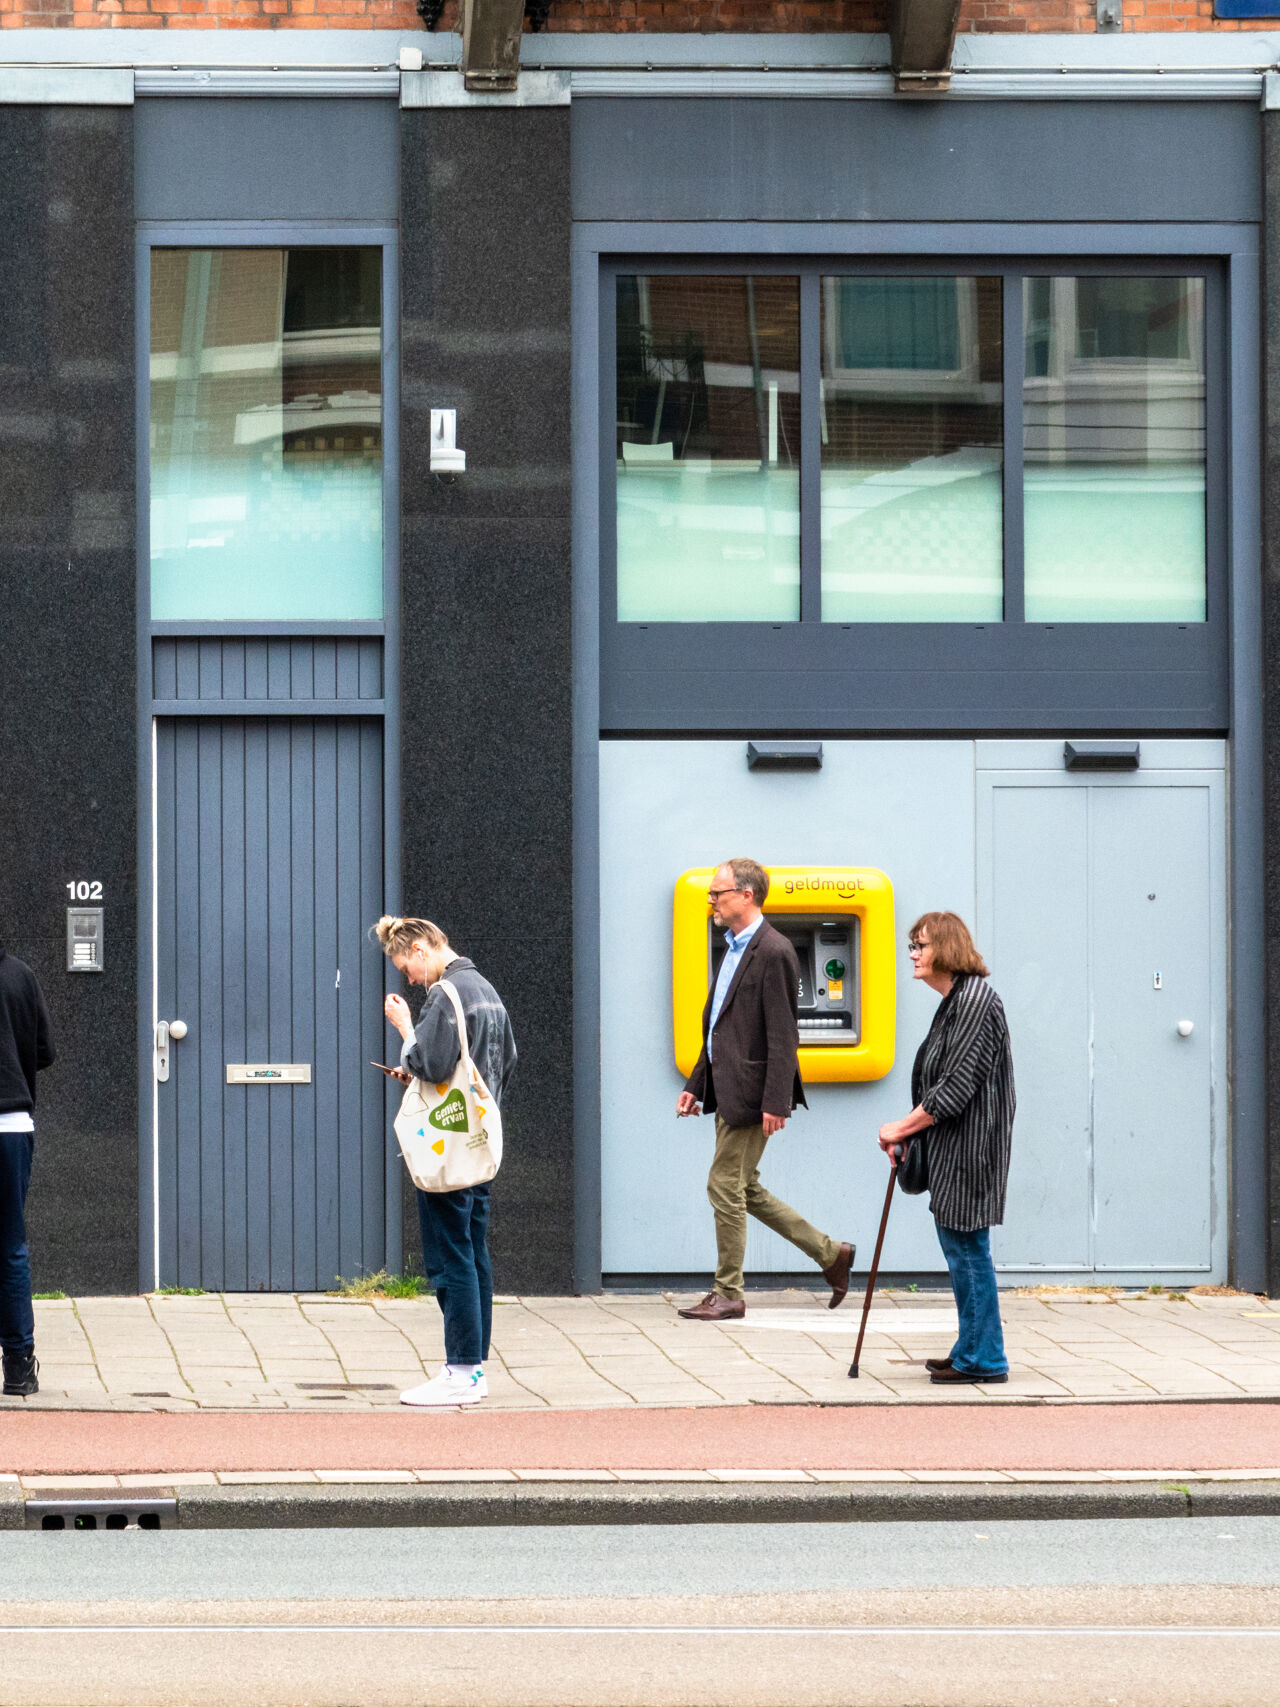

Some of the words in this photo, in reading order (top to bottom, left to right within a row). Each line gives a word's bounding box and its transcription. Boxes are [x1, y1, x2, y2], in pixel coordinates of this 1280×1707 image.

[66, 881, 103, 900] 102
[785, 877, 865, 894] geldmaat
[442, 1112, 464, 1127] ervan
